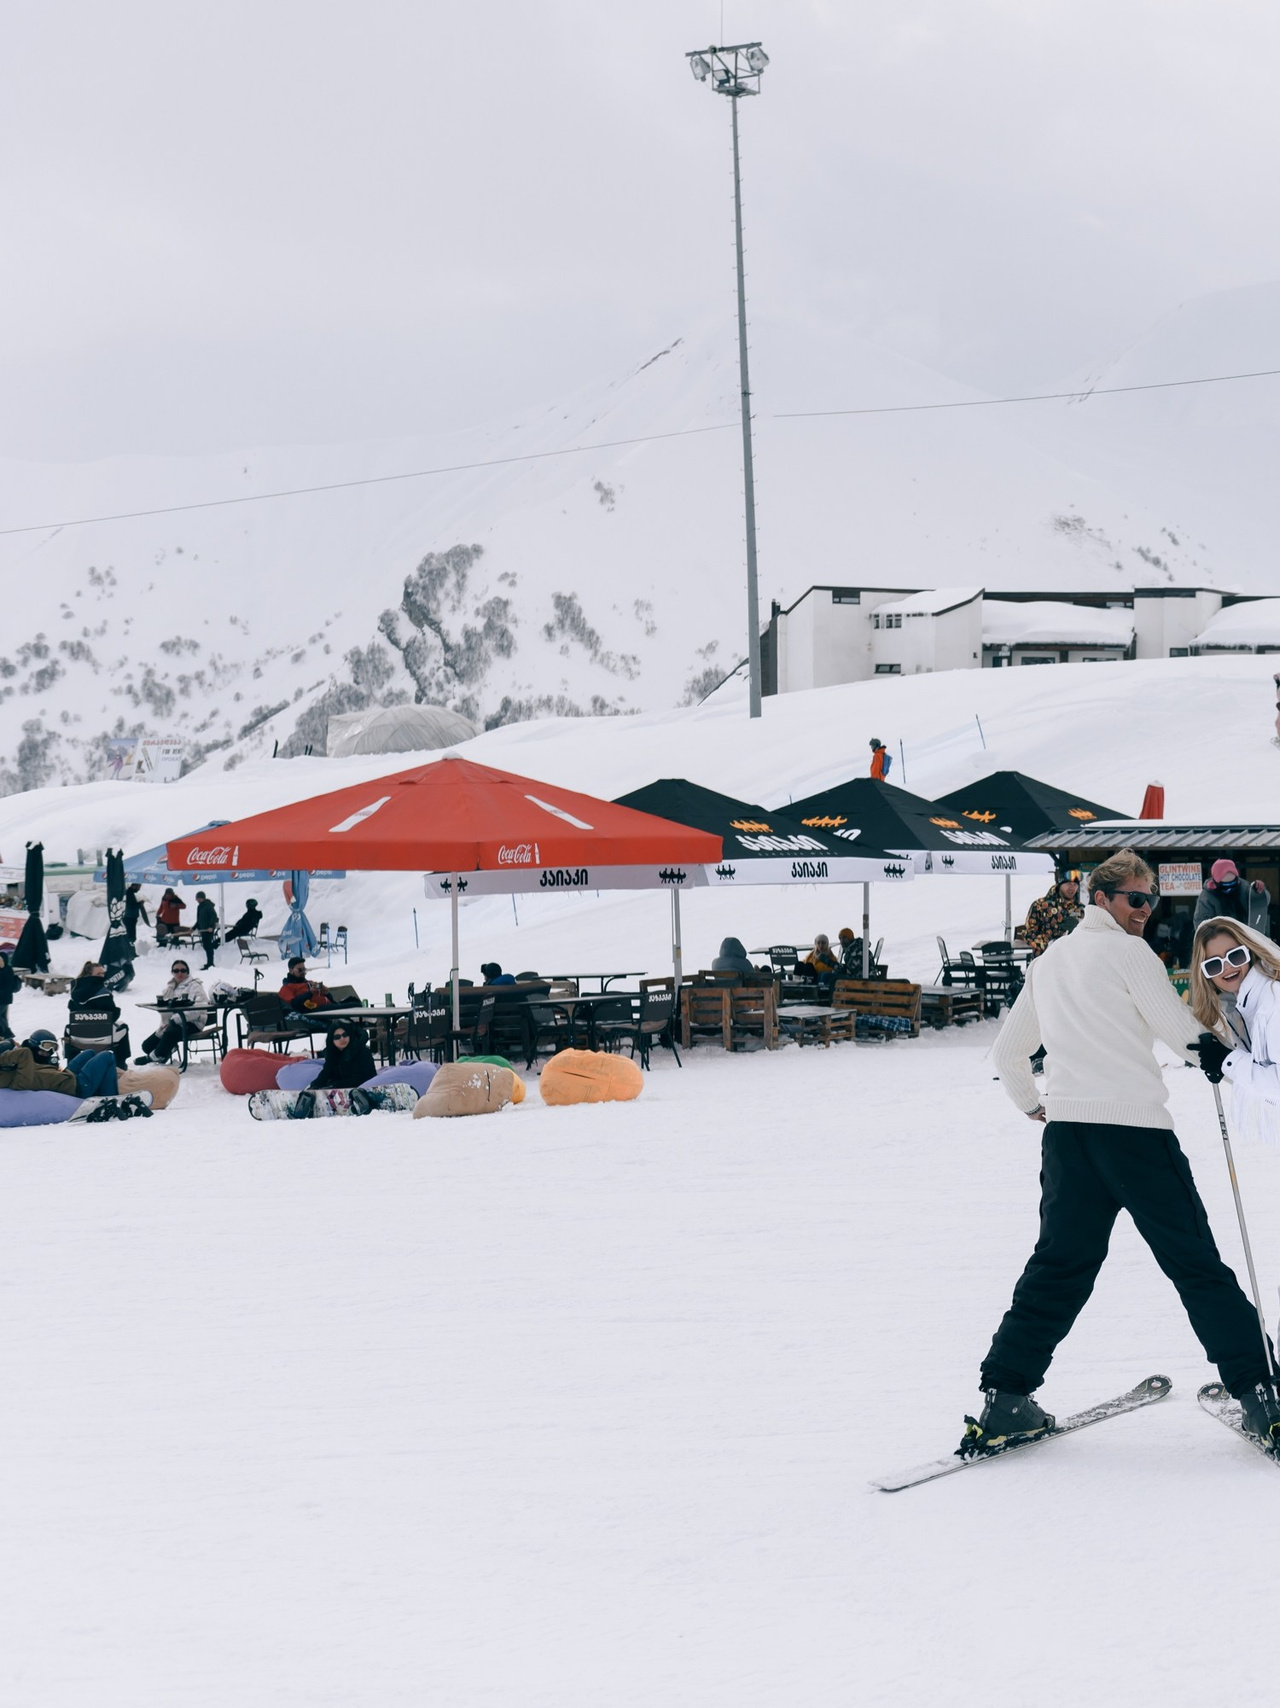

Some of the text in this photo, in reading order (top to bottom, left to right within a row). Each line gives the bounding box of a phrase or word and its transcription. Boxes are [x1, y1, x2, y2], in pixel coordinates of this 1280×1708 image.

[186, 846, 232, 865] Coca-Cola
[498, 844, 533, 865] Coca-Cola
[791, 861, 829, 878] კაიაკი
[991, 856, 1017, 870] კაიაკი
[1160, 864, 1201, 873] GLINTWINE
[540, 868, 589, 887] კაიაკი
[1160, 873, 1201, 881] HOT CHOCOLATE
[1160, 882, 1175, 890] TEA
[1184, 881, 1201, 890] COFFEE
